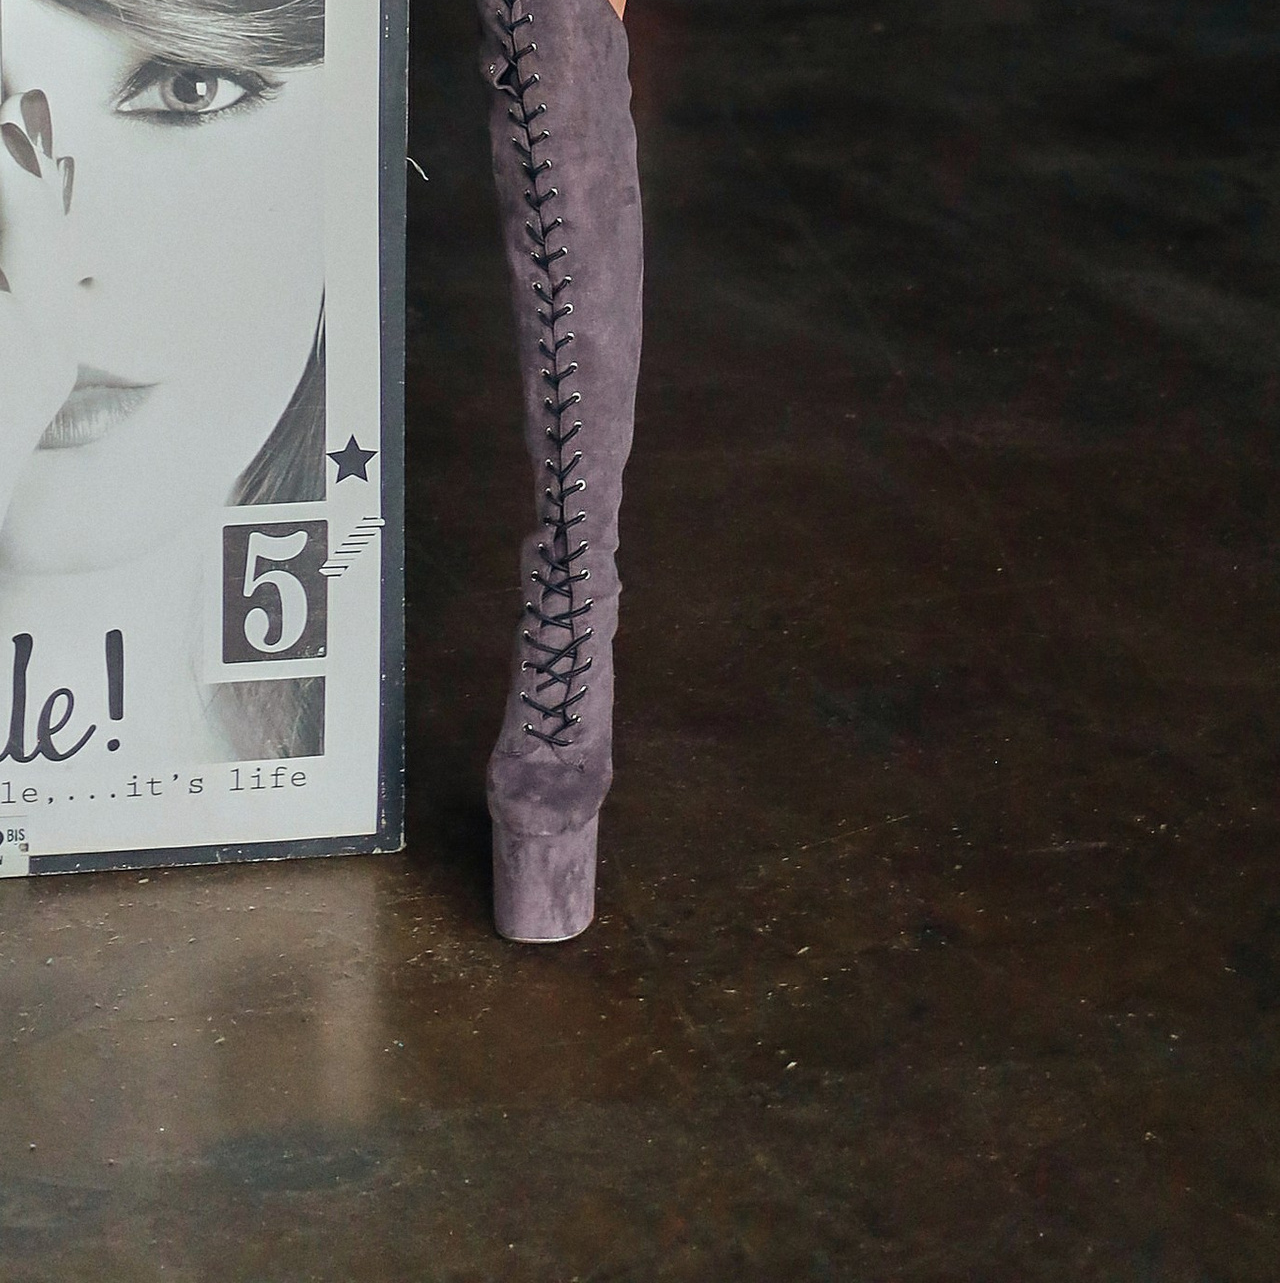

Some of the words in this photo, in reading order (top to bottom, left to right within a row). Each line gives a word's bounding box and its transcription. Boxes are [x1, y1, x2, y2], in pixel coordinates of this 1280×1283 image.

[243, 529, 309, 654] 5
[229, 766, 308, 793] life
[6, 828, 25, 843] BIS
